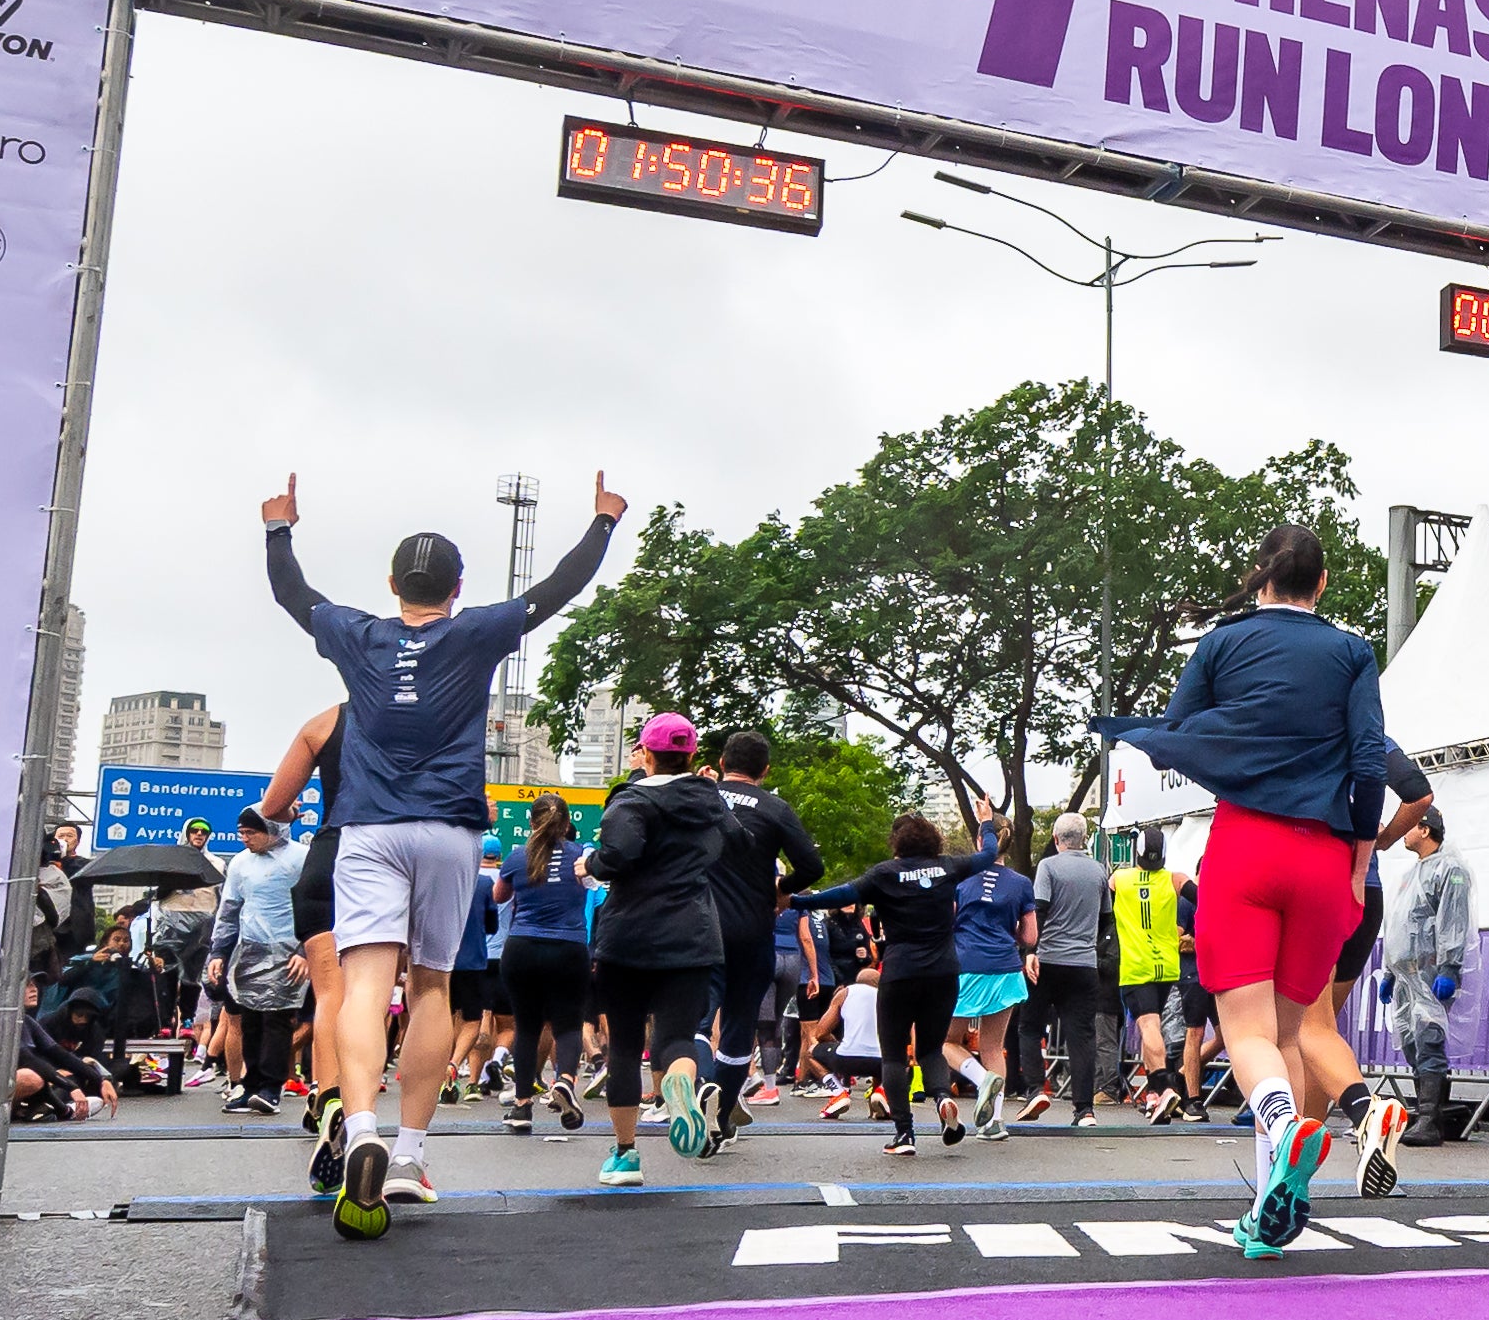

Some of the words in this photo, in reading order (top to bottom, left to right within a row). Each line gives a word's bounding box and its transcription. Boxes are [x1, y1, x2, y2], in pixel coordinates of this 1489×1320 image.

[570, 127, 813, 212] 01:50:36
[1161, 769, 1195, 792] POST
[140, 781, 245, 798] Bandeirantes
[137, 803, 184, 818] Dutra
[135, 827, 184, 841] Ayrto
